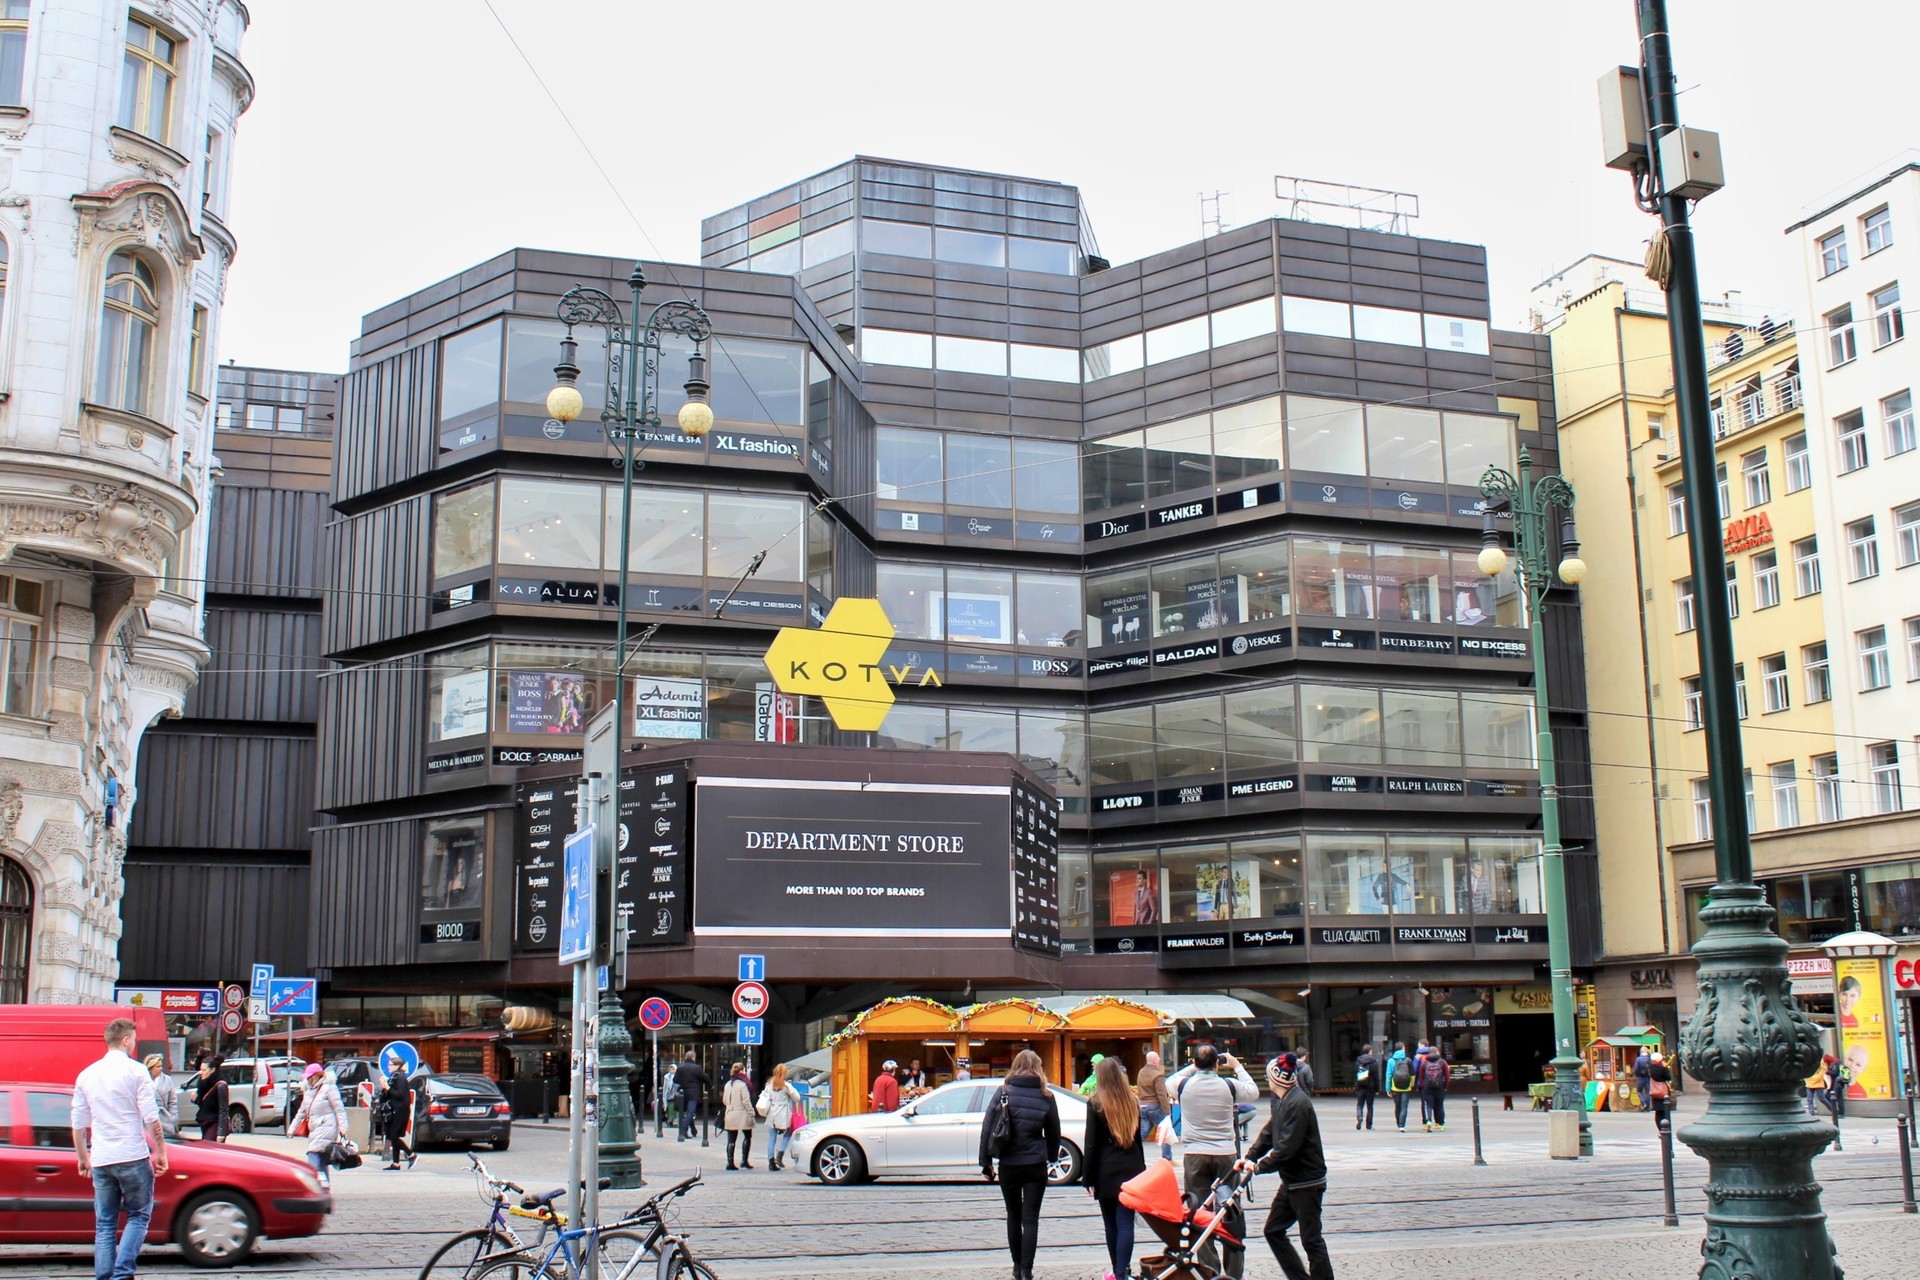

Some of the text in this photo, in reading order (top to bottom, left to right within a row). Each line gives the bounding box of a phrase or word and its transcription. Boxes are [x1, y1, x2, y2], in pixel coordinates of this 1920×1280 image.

[460, 432, 476, 446] FENDI
[716, 435, 798, 456] XL fashion
[1101, 521, 1129, 538] Dior
[1212, 578, 1235, 588] CYSTAL
[1454, 580, 1480, 589] ORCELAIN
[500, 585, 594, 599] KAPALUA
[763, 600, 802, 610] DESIGN
[1103, 594, 1148, 607] BOHEMIA CRYSTAL
[1112, 604, 1139, 614] PORCELAIN
[948, 617, 972, 626] illeroy
[978, 617, 996, 626] Boch
[1248, 634, 1282, 648] VERSACE
[1381, 637, 1452, 650] BURBERRY
[1462, 640, 1526, 651] NO EXCESS
[1155, 646, 1216, 663] BALDAN
[1032, 660, 1069, 672] BOSS
[518, 674, 540, 682] ARMANI
[790, 661, 943, 688] KOTVA
[518, 690, 542, 698] BOSS
[640, 706, 702, 720] XL fashion
[454, 754, 485, 767] HAMILTON
[500, 752, 532, 762] DOLCE
[1331, 776, 1356, 786] AGATHA
[1389, 780, 1462, 792] RALPH LAUREN
[1178, 786, 1202, 796] ARMANI
[1232, 780, 1294, 796] PME LEGEND
[1102, 796, 1143, 810] LLOYD
[1180, 795, 1202, 804] JUNIOR
[530, 824, 551, 834] GOSH
[746, 831, 964, 854] DEPARTMENT STORE
[652, 866, 672, 874] ARMANI
[654, 874, 671, 883] JUNIOR
[786, 886, 926, 898] MORE THAN 100 TOP BRANDS
[1322, 930, 1344, 942] ELISA
[1399, 928, 1466, 939] FRANK LYMAN
[1167, 938, 1224, 948] FRANK WALDER
[1788, 960, 1814, 972] PIZZA
[256, 968, 268, 987] P
[1631, 968, 1673, 986] SLAVIA
[708, 1006, 736, 1024] STREET
[1434, 1020, 1490, 1028] PIZZA GYROS TORTILLA
[744, 1026, 756, 1038] 10
